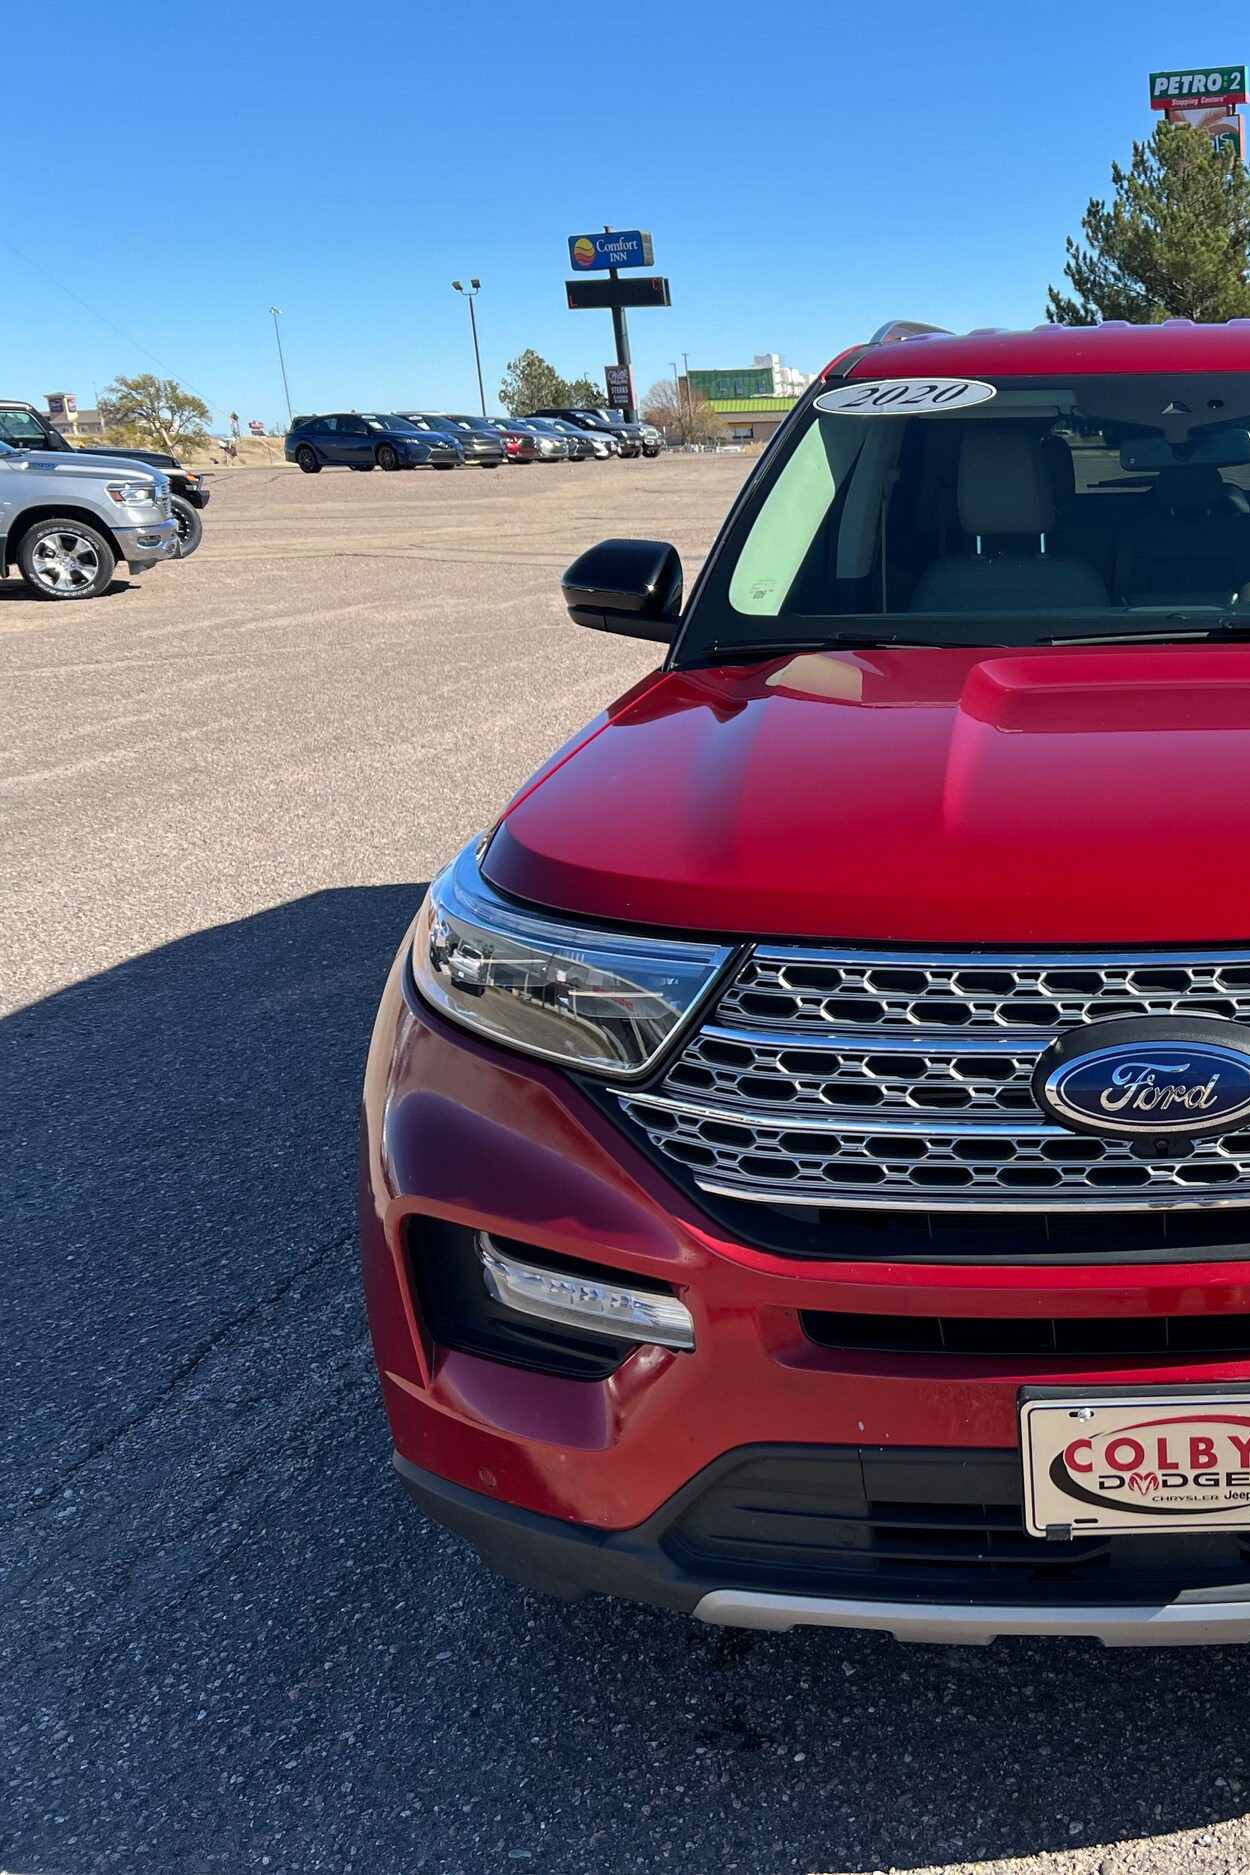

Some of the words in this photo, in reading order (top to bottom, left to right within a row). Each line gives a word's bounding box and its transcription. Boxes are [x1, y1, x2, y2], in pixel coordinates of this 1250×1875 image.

[596, 237, 638, 252] Comfort
[609, 252, 627, 262] INN
[838, 384, 969, 408] 2020
[1100, 1062, 1218, 1112] Ford
[1152, 1494, 1219, 1502] CHRYSLER
